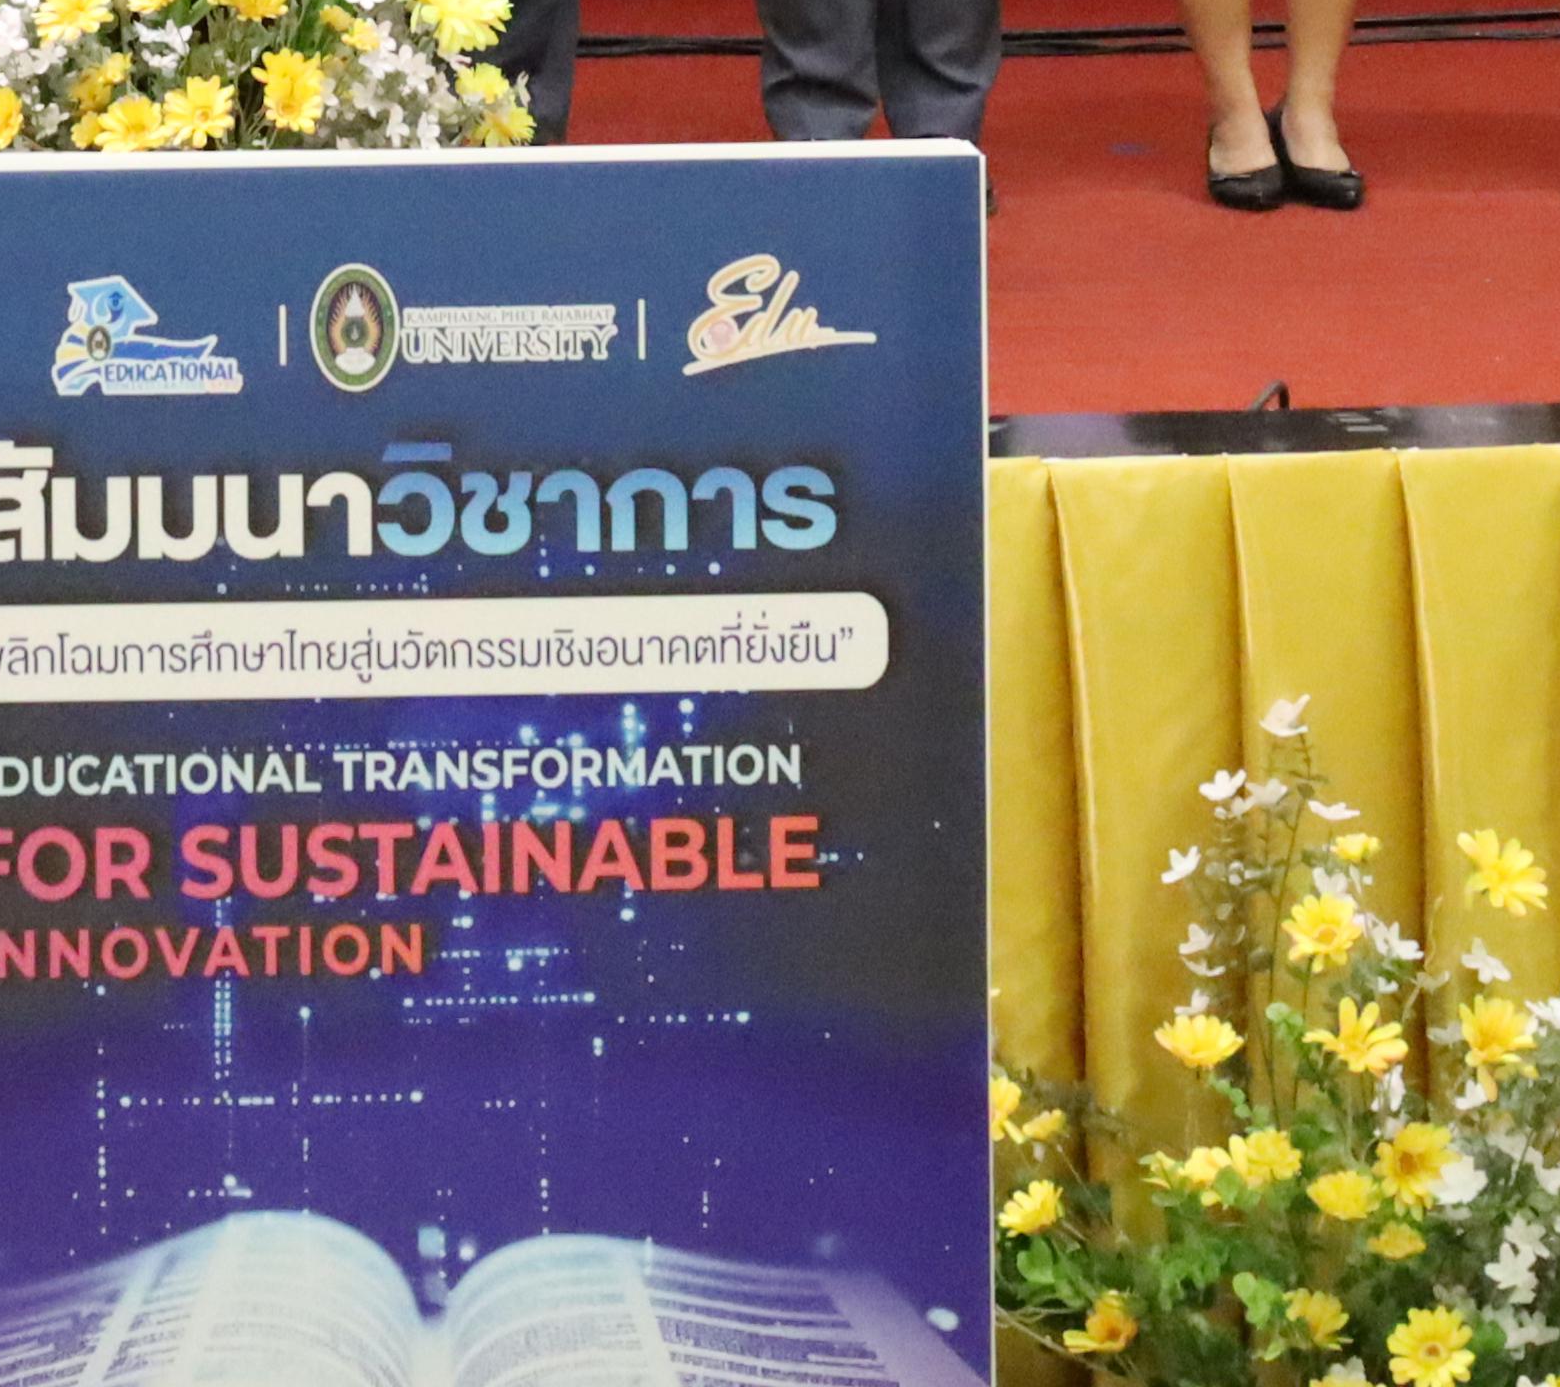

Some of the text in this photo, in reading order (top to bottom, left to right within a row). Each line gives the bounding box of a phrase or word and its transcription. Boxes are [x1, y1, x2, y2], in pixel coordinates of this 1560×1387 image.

[404, 327, 612, 361] UNIVERSITY
[334, 742, 802, 793] TRANSFORMATION
[180, 815, 821, 899] SUSTAINABLE
